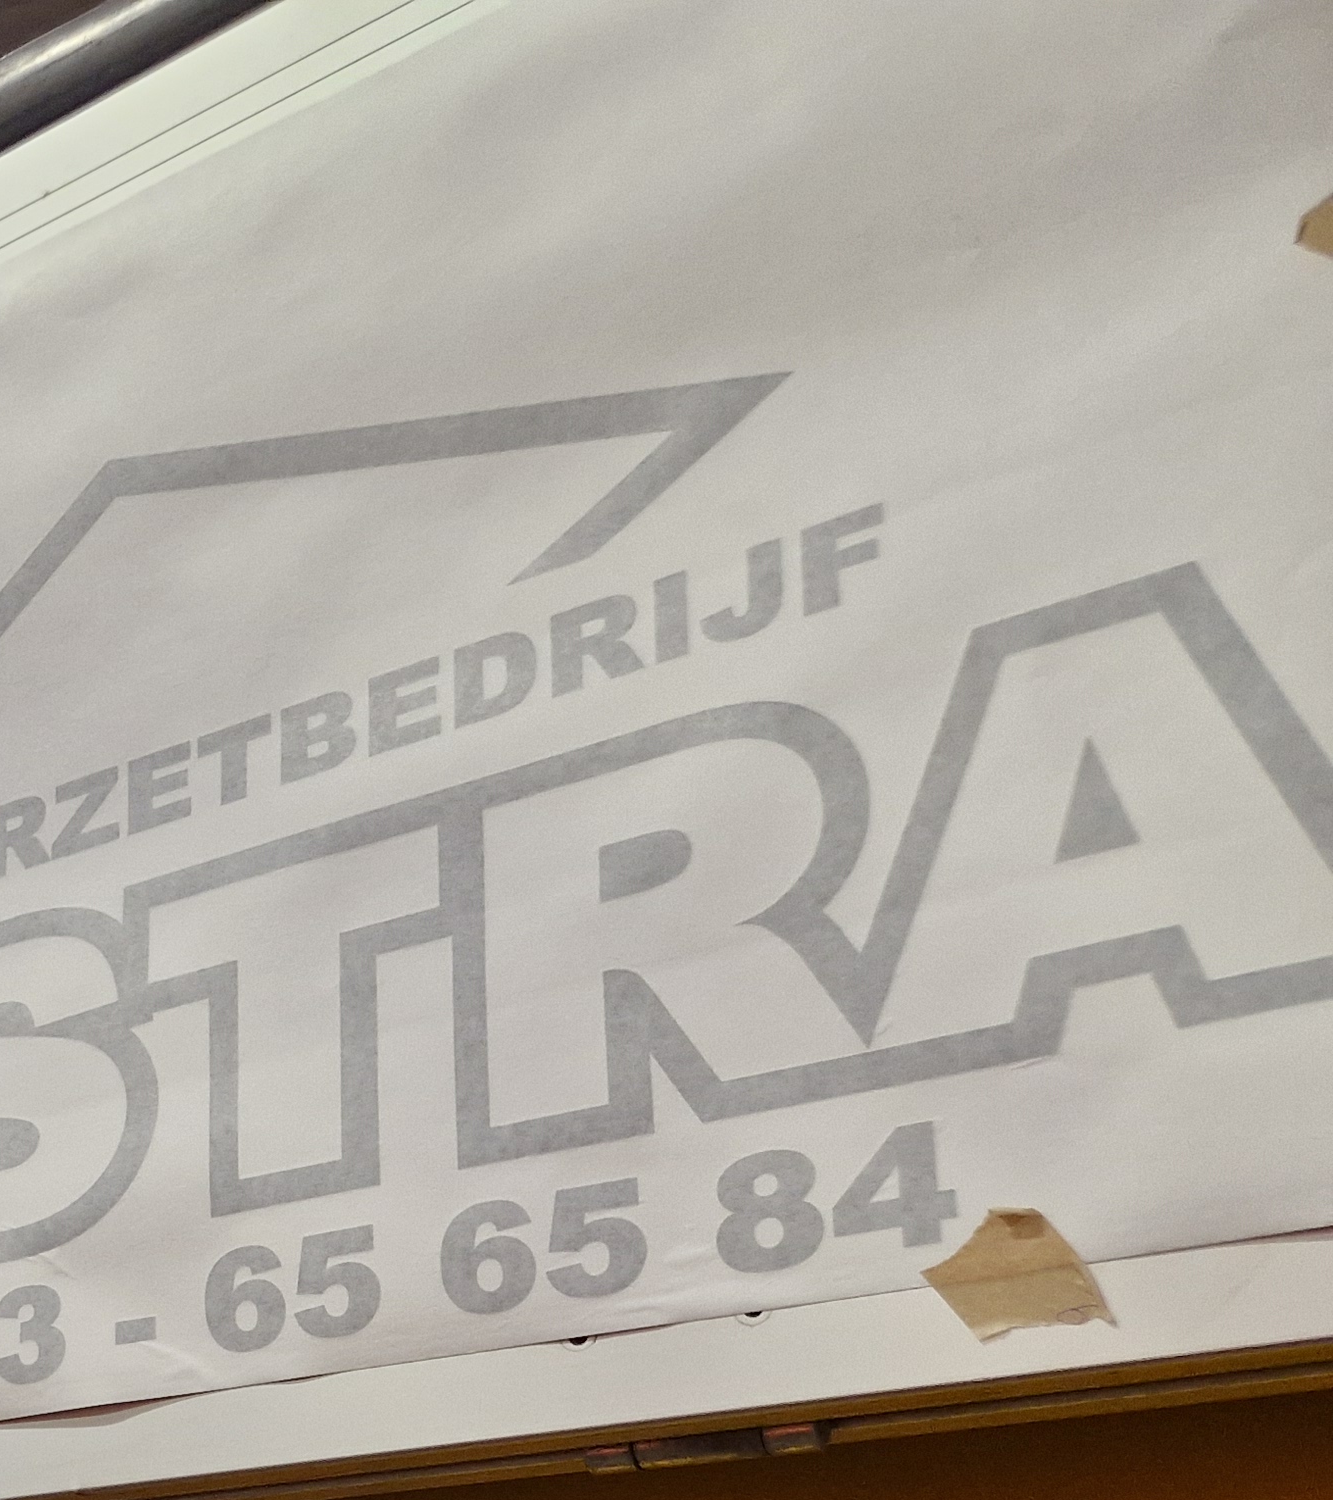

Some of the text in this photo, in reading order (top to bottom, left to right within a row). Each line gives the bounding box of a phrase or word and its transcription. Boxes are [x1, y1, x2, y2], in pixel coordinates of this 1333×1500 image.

[203, 1224, 383, 1354] 65
[439, 1177, 650, 1321] 65
[714, 1120, 960, 1276] 84
